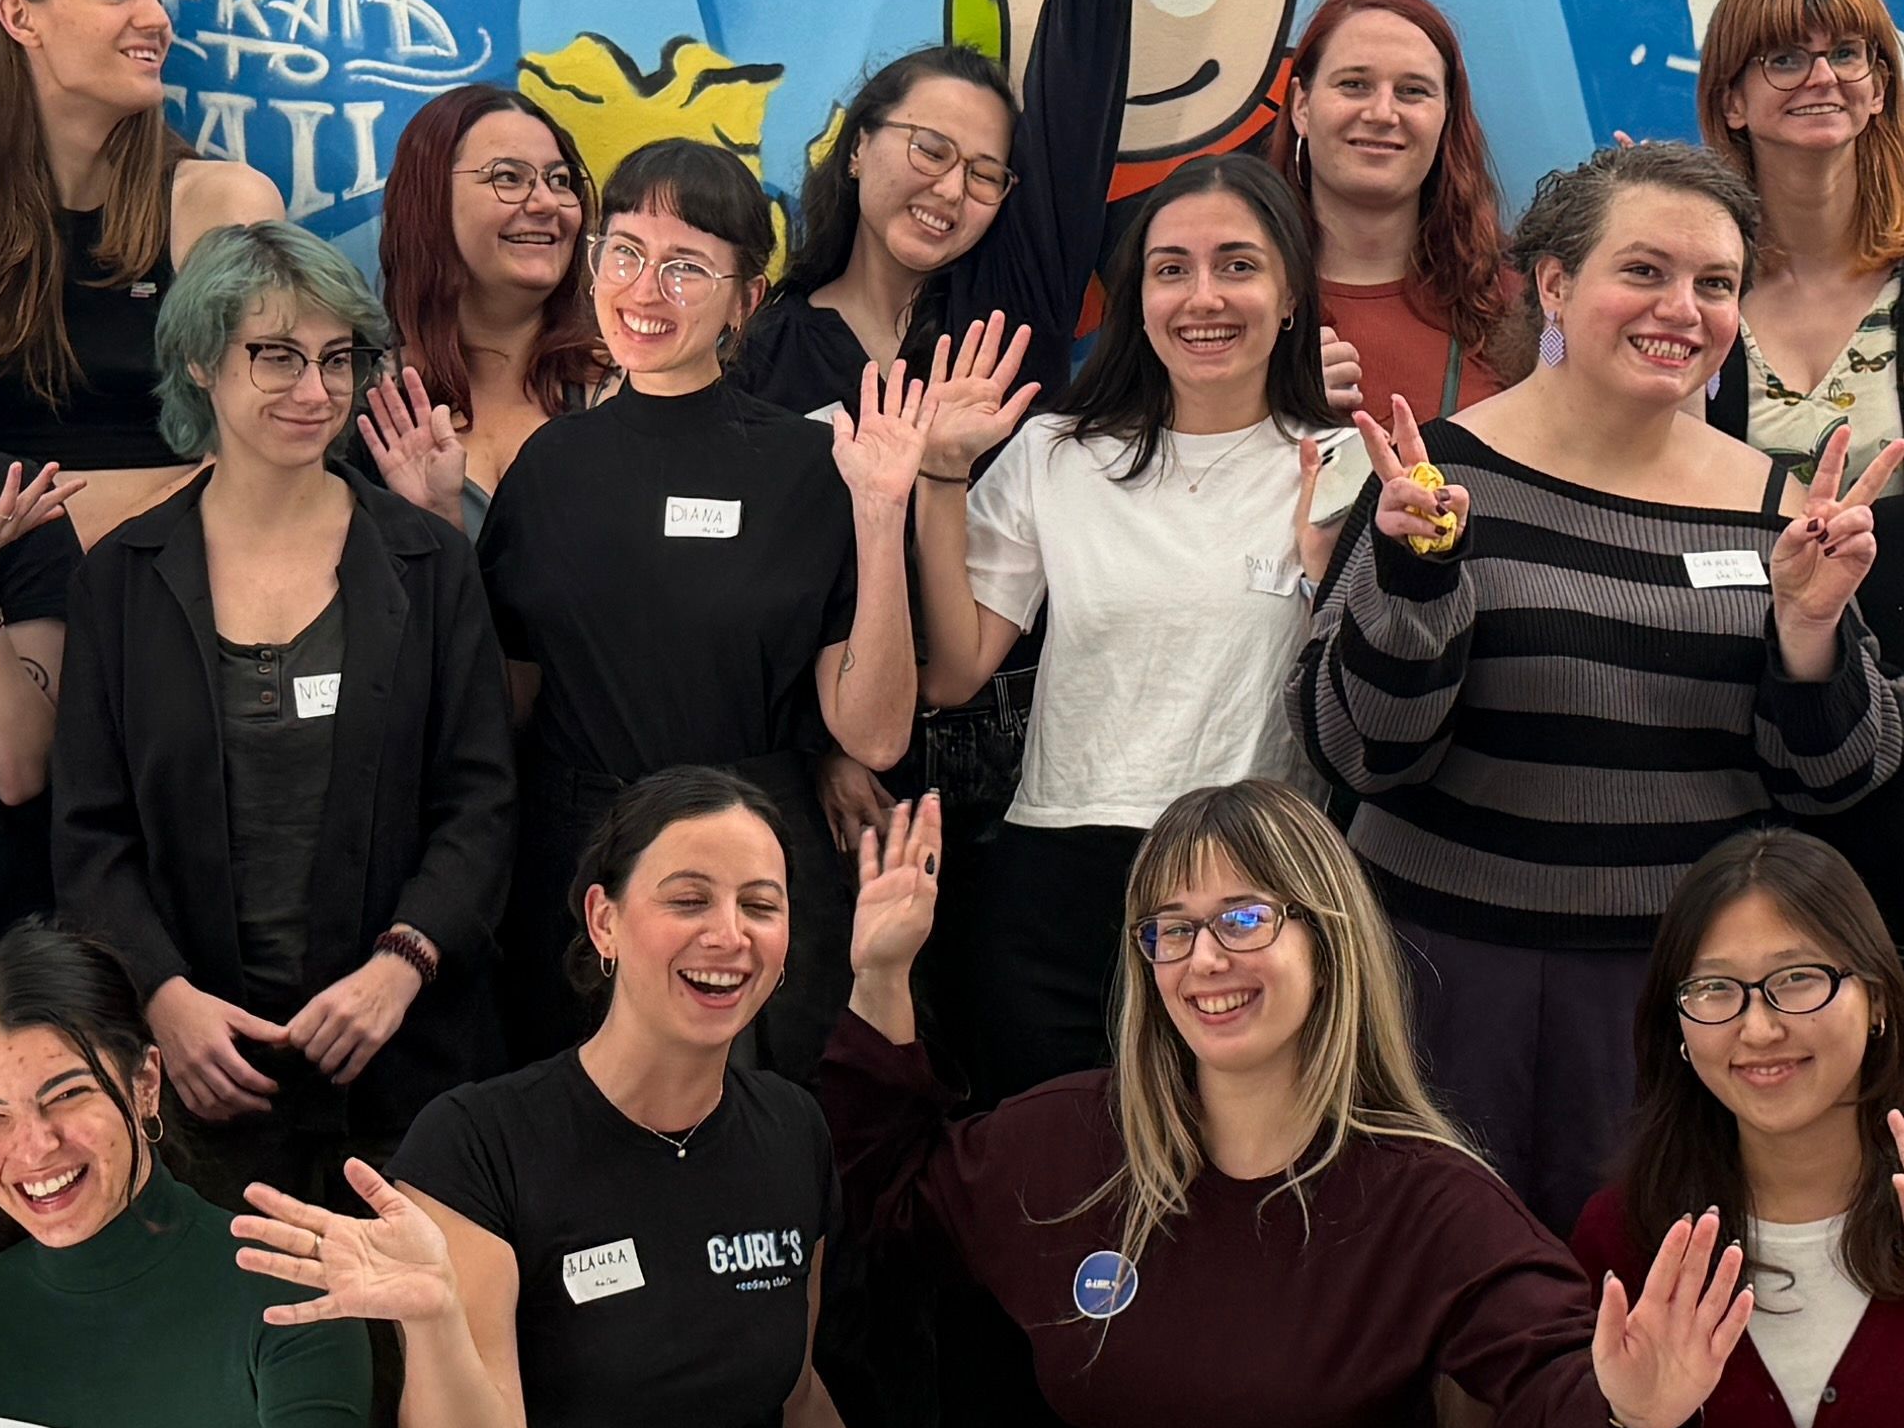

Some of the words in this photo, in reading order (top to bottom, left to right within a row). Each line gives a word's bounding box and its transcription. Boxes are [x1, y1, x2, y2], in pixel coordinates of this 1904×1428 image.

[196, 30, 330, 82] TO
[162, 86, 388, 218] AIL
[671, 504, 722, 524] DIANA
[579, 1248, 628, 1273] LAURA
